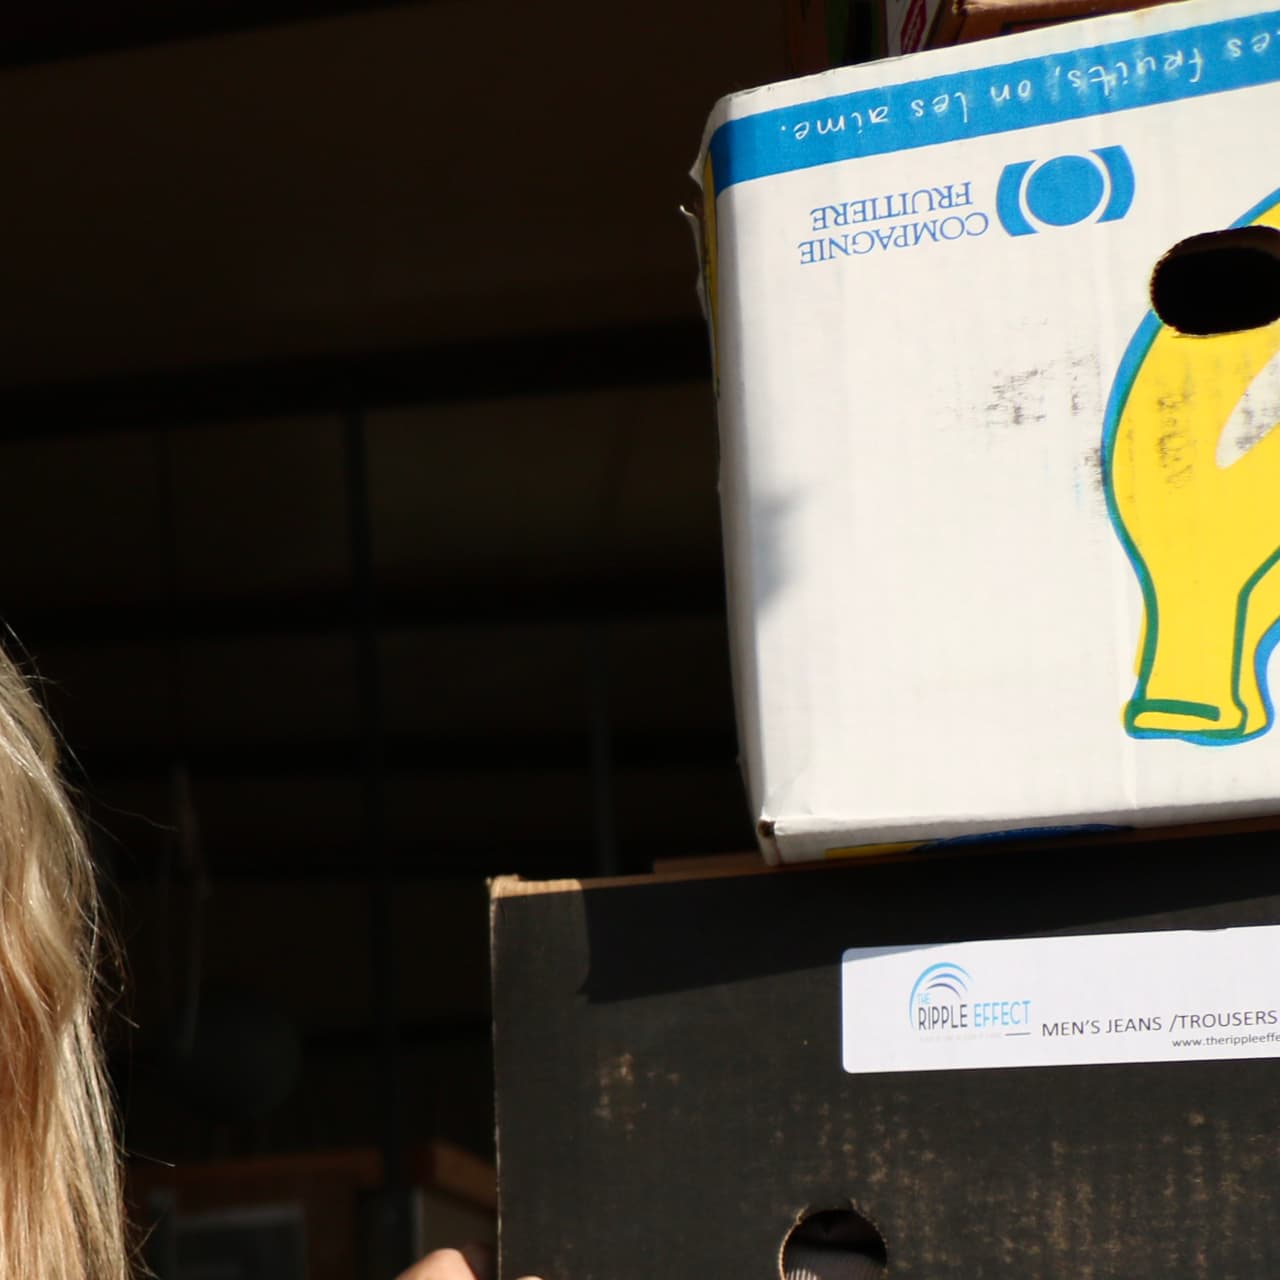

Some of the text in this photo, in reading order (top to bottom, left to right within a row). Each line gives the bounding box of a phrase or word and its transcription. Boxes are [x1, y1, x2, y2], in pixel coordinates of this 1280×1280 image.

[779, 30, 1280, 140] es fruits, on les aime.
[809, 181, 973, 232] FRUITIERE
[797, 212, 989, 265] COMPAGNIE
[917, 992, 931, 1004] THE
[917, 1000, 1278, 1036] RIPPLE EFFECT MEN'S JEANS /TROUSERS
